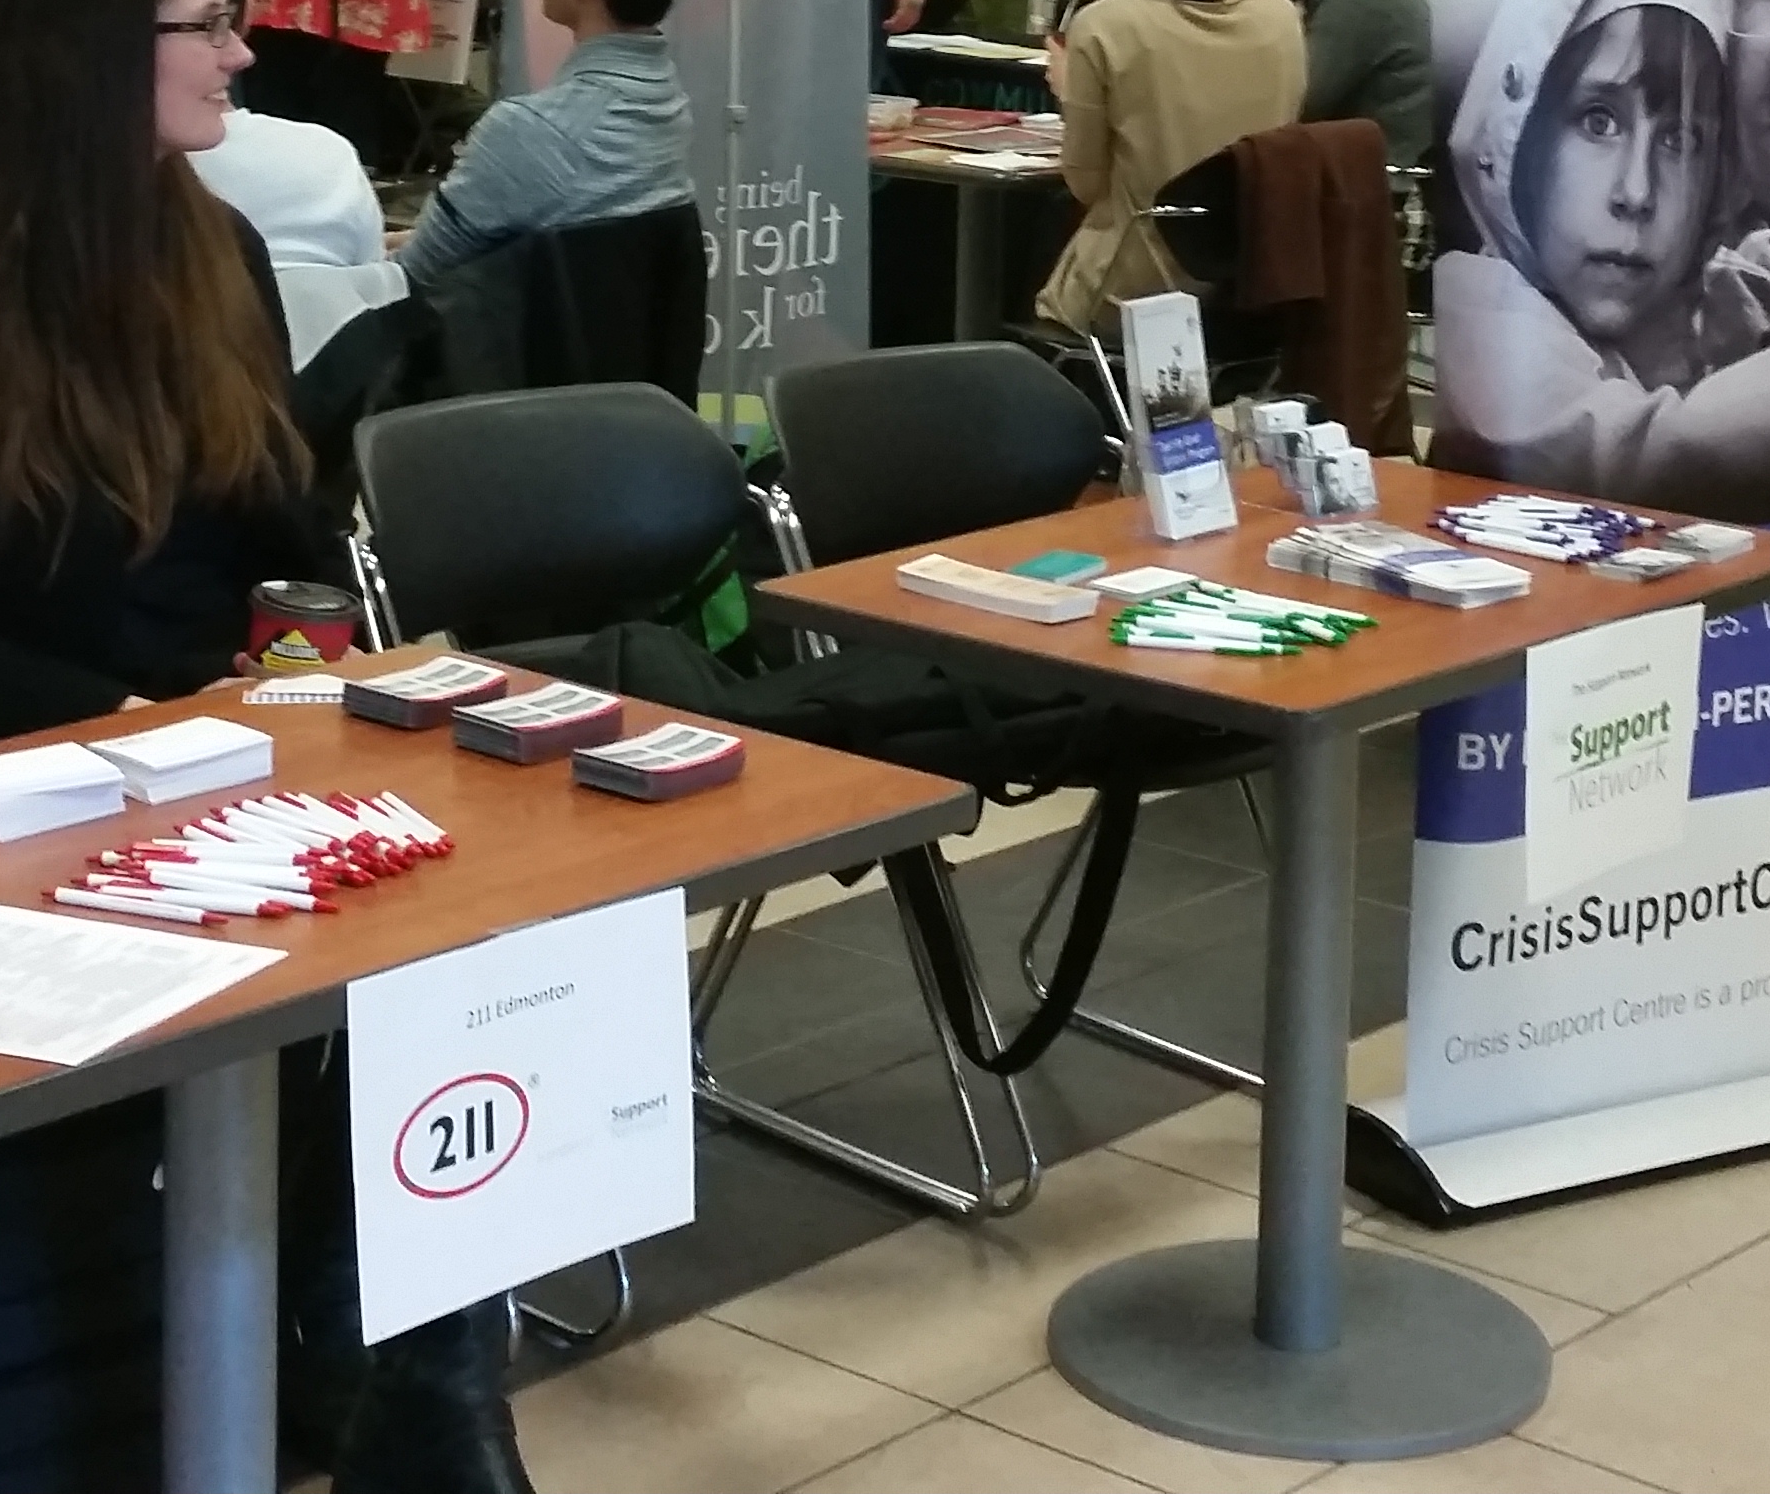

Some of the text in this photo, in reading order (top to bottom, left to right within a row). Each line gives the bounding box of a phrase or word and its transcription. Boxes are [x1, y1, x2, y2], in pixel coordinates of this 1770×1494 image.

[1457, 731, 1510, 772] BY
[1570, 700, 1671, 762] Support
[1569, 748, 1668, 815] Network
[467, 980, 575, 1029] 211 Edmonton
[1445, 1028, 1510, 1066] Crisis
[1518, 1006, 1605, 1051] Support
[1613, 990, 1687, 1032] Centre
[1693, 982, 1712, 1012] is
[1718, 984, 1734, 1005] a
[430, 1100, 494, 1173] 211
[611, 1093, 668, 1122] Support
